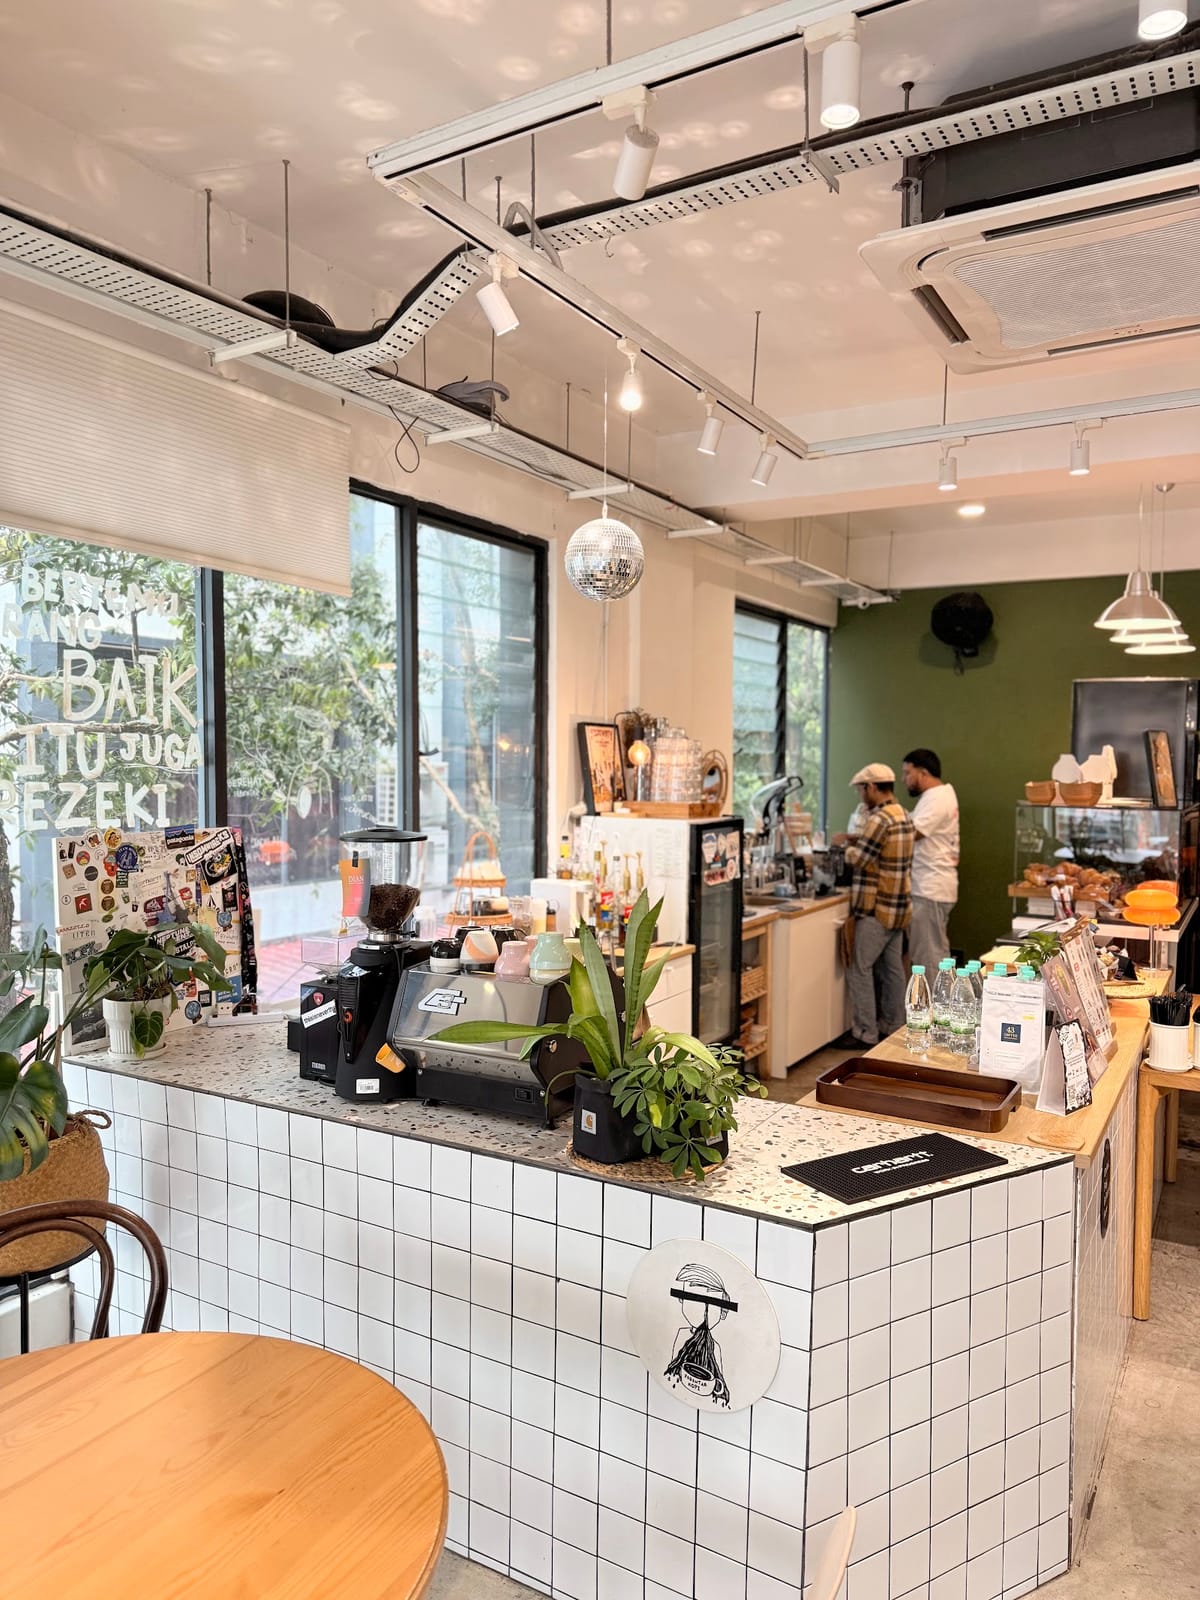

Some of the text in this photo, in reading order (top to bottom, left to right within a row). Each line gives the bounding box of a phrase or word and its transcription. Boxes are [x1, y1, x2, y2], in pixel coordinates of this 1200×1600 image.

[62, 649, 199, 730] BAIK
[16, 723, 204, 780] ITU JUGA
